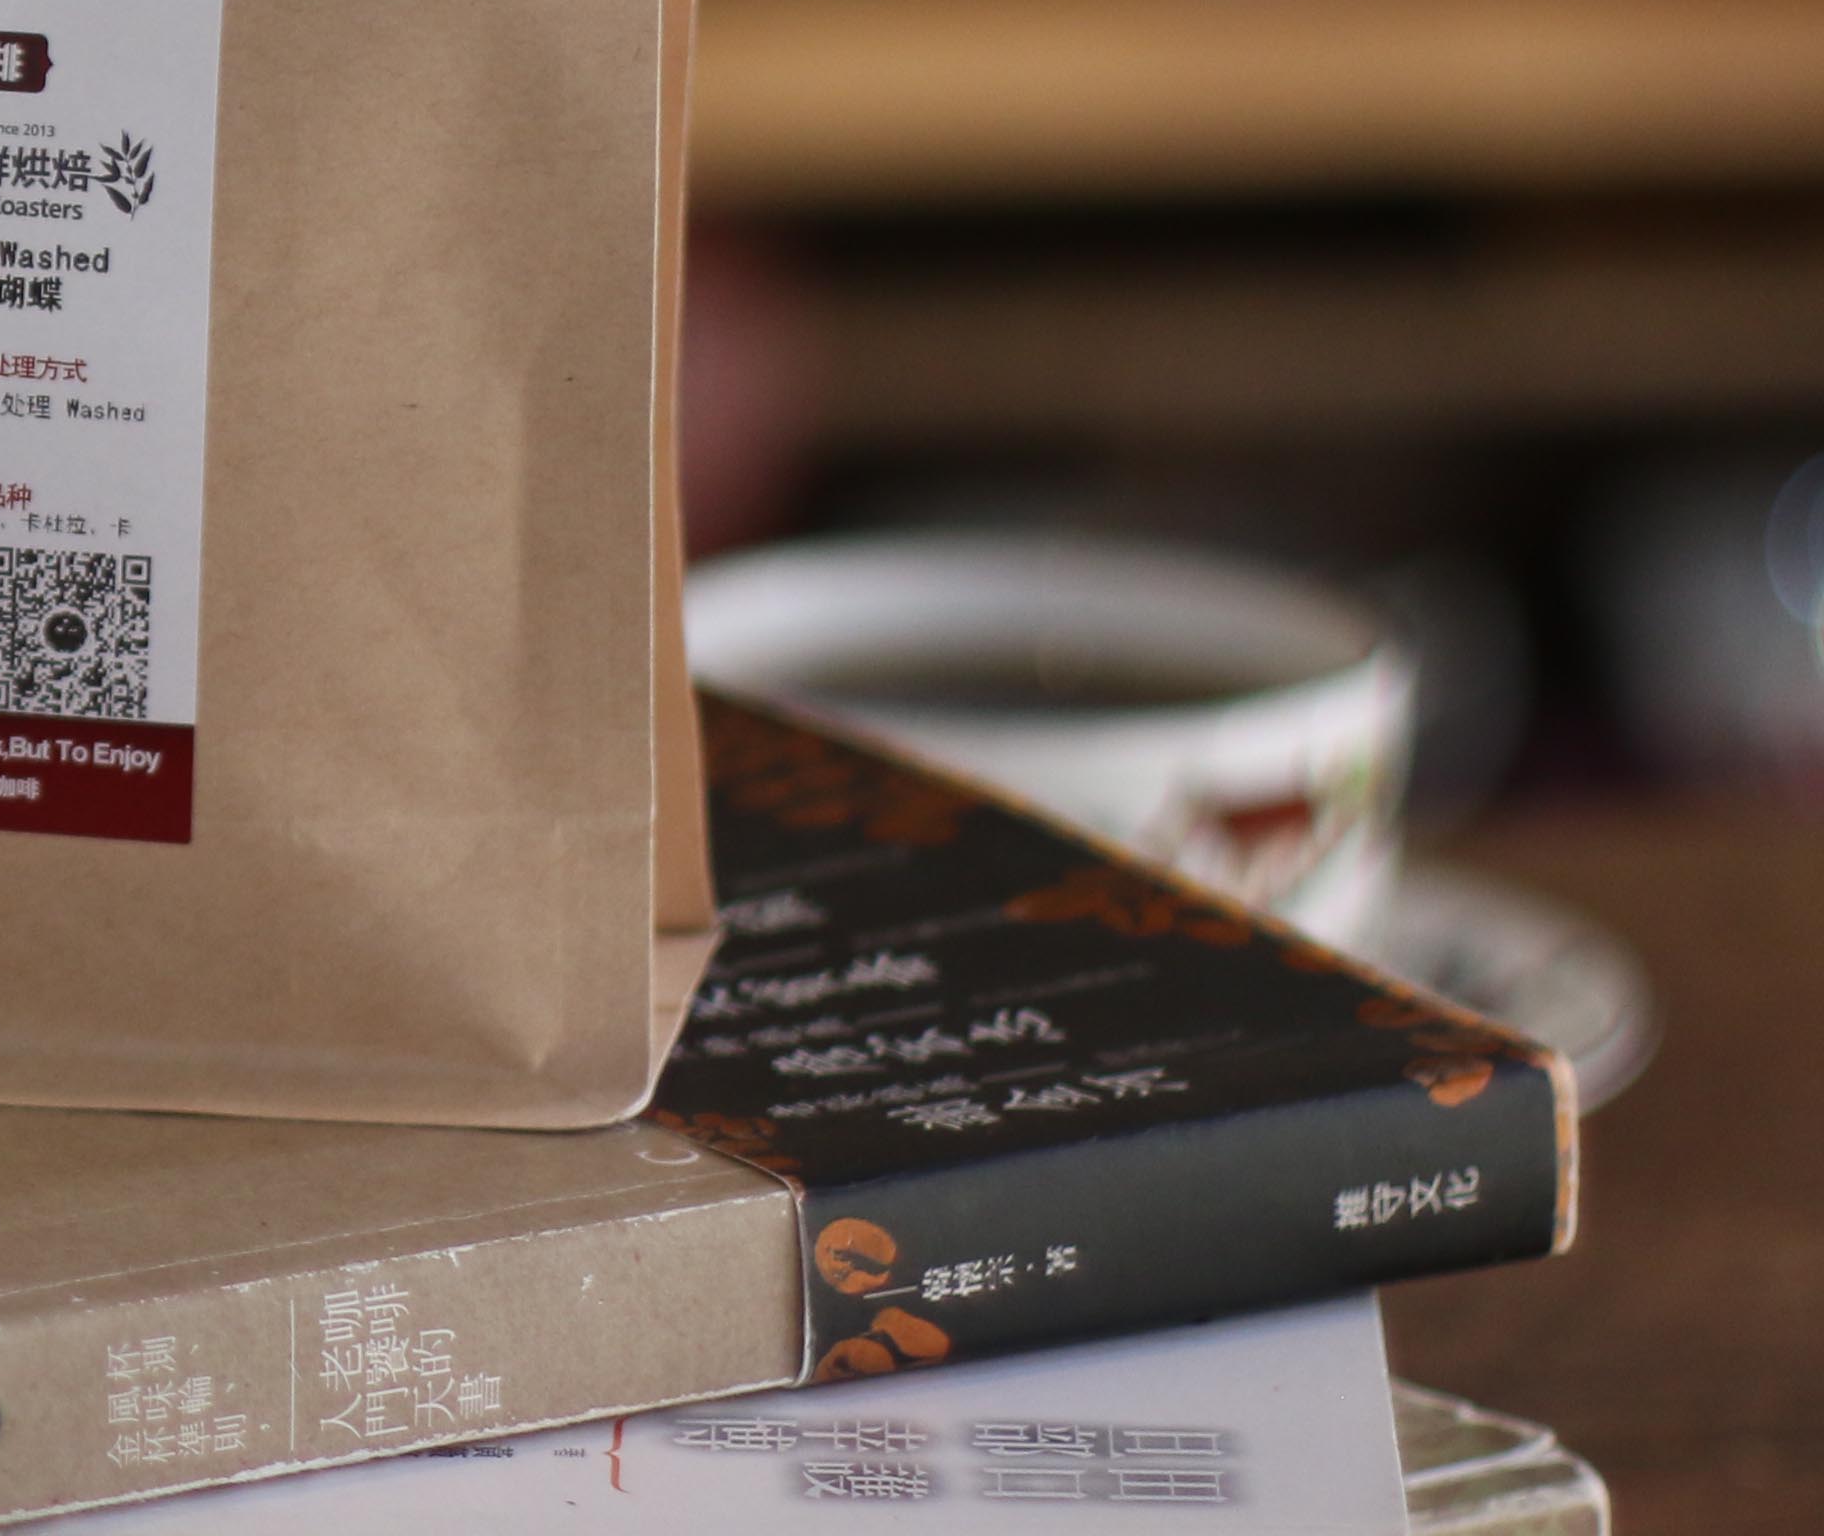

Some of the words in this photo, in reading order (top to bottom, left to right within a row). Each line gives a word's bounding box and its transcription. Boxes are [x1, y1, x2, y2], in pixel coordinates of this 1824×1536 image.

[23, 122, 56, 138] 2013
[66, 398, 146, 422] Washed
[55, 739, 88, 763] To
[93, 742, 161, 773] Enjoy
